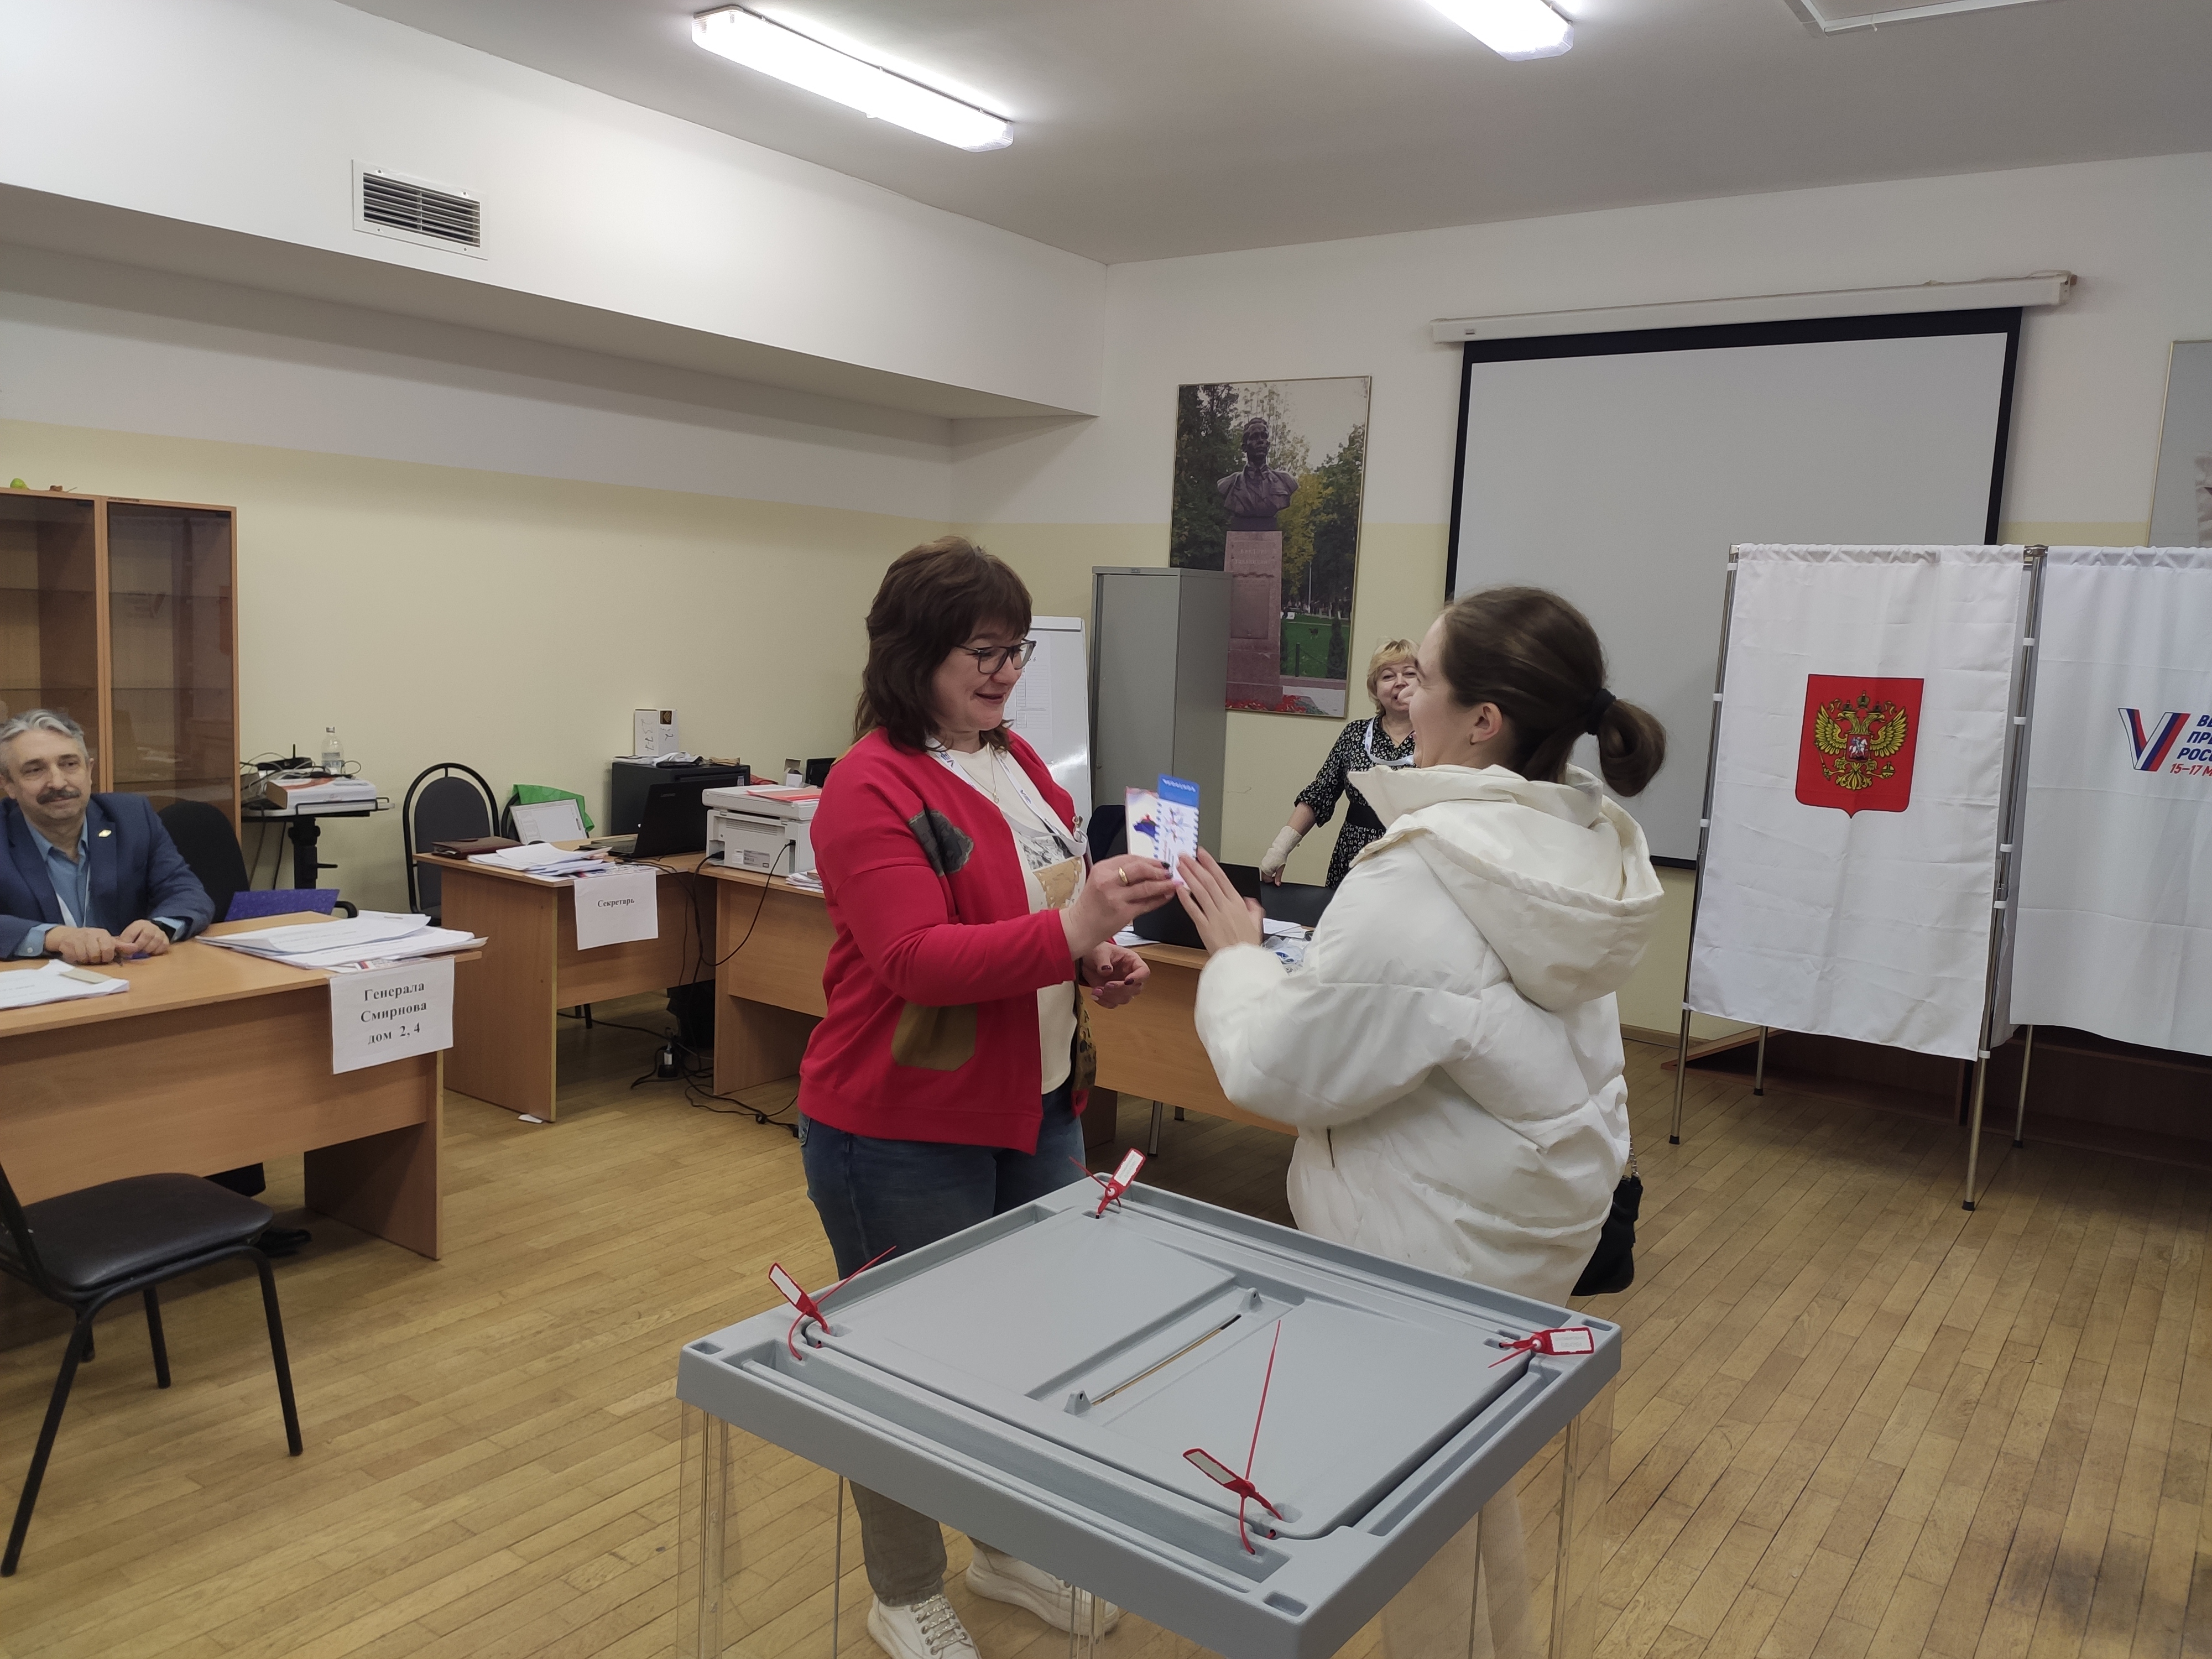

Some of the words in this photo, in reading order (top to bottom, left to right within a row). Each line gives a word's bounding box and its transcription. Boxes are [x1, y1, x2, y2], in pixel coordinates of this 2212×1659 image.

[2177, 748, 2212, 762] РОС
[597, 898, 635, 907] Секретарь
[364, 982, 425, 1001] Генерала
[361, 1002, 427, 1023] Смирнова
[367, 1030, 393, 1045] дом
[399, 1025, 411, 1038] 2,
[413, 1022, 420, 1034] 4
